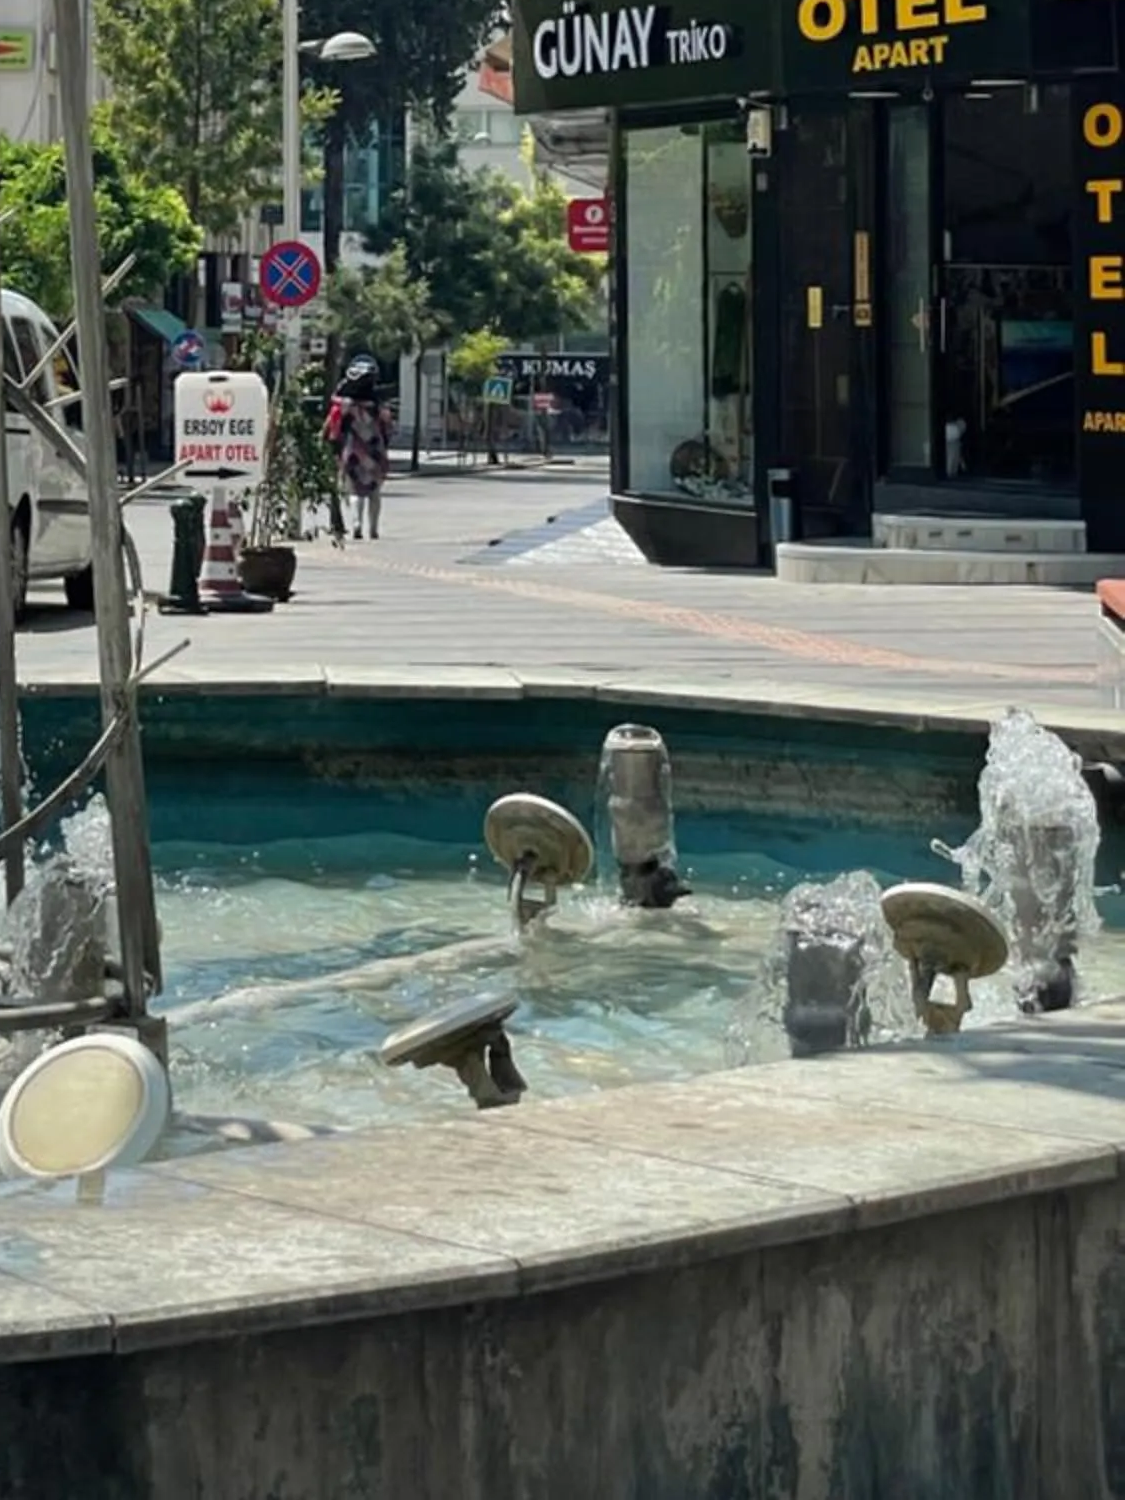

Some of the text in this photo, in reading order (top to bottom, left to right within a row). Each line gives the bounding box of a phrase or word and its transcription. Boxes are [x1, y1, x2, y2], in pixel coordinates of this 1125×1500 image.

[533, 0, 727, 79] GÜNAY TRİKO
[852, 35, 949, 73] APART
[1083, 103, 1125, 376] OTEL
[522, 359, 597, 380] KUMAŞ
[184, 419, 254, 436] ERSOY EGE
[180, 443, 259, 461] APART OTEL
